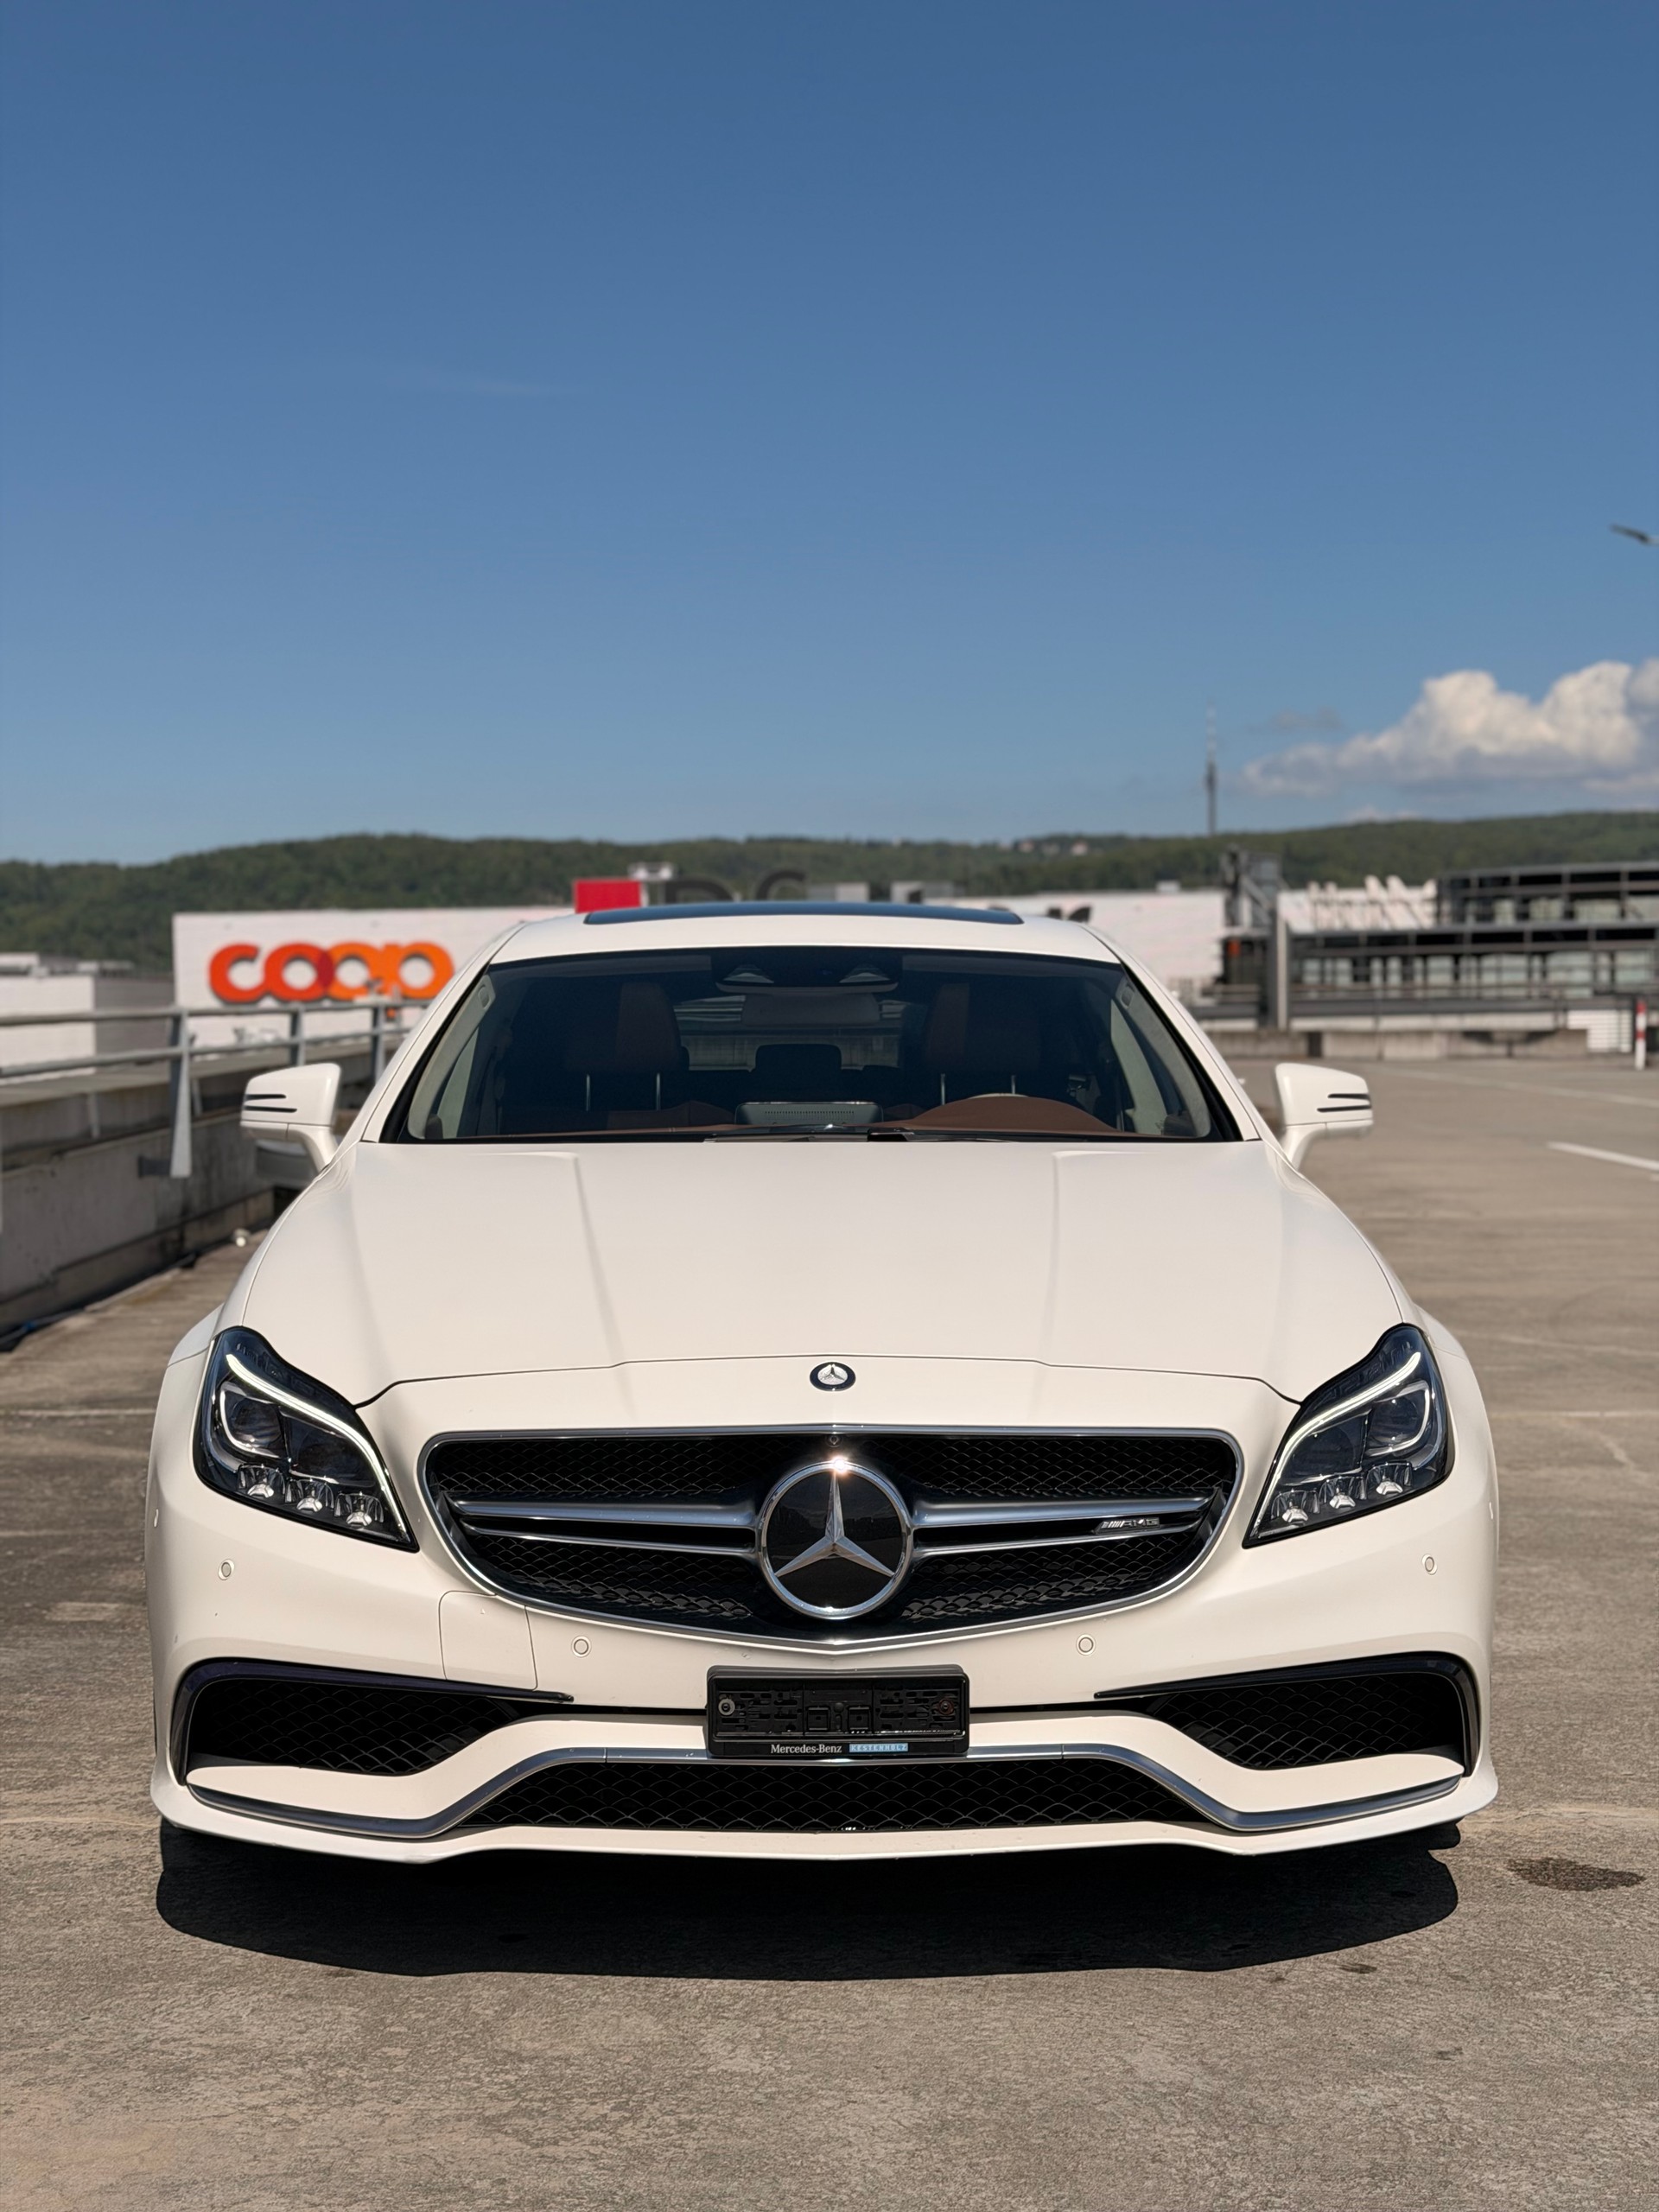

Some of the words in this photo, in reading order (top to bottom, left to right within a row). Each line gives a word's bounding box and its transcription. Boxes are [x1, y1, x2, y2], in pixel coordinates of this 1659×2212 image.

[209, 942, 454, 1003] coop
[771, 1744, 842, 1754] Mercedes-Benz
[850, 1744, 907, 1752] KESTENHOLZ
